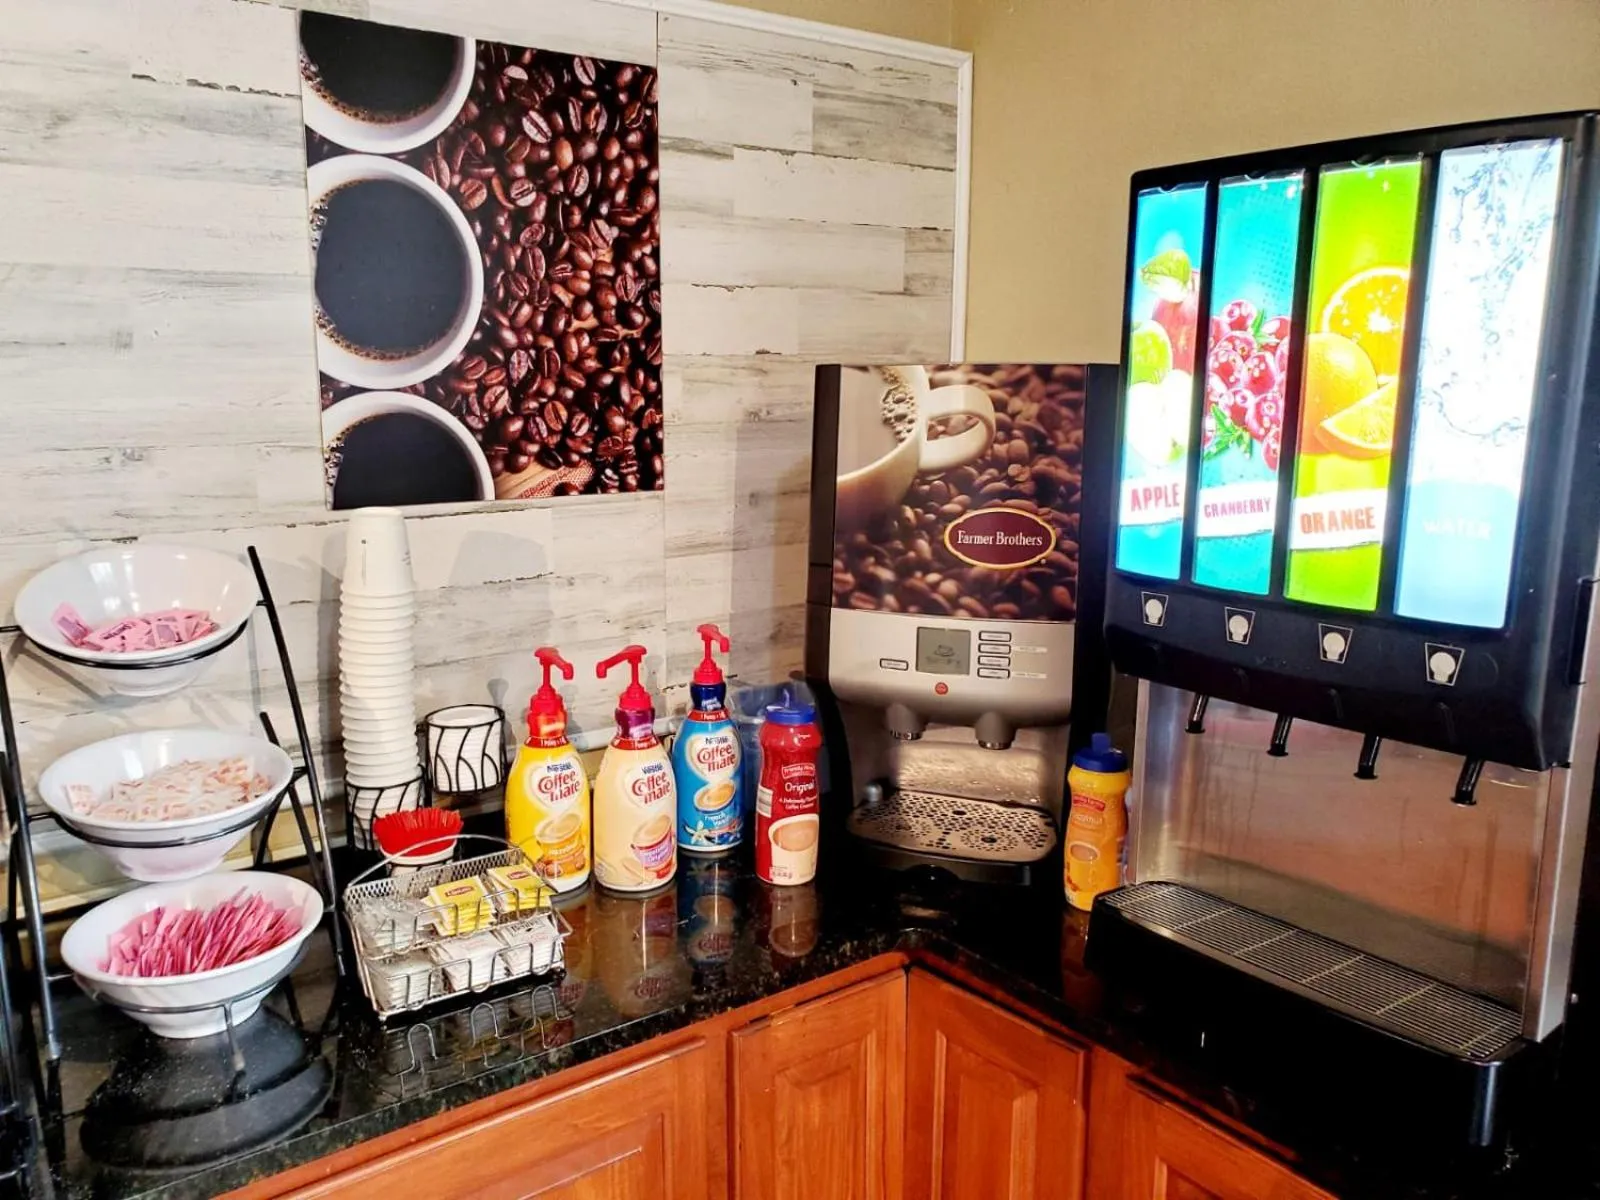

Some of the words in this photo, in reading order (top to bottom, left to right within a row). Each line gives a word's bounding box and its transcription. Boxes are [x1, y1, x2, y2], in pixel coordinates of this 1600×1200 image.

[1130, 482, 1181, 512] APPLE
[1203, 497, 1271, 519] CRANBERRY
[1299, 506, 1376, 534] ORANGE
[1423, 517, 1492, 541] WATER
[957, 530, 994, 545] Farmer
[995, 531, 1043, 546] Brothers
[697, 744, 733, 764] Coffee
[707, 754, 736, 772] mate
[538, 770, 576, 794] Coffee
[549, 780, 580, 802] mate
[632, 771, 667, 796] Coffee
[643, 780, 671, 804] mate
[784, 780, 815, 797] Original
